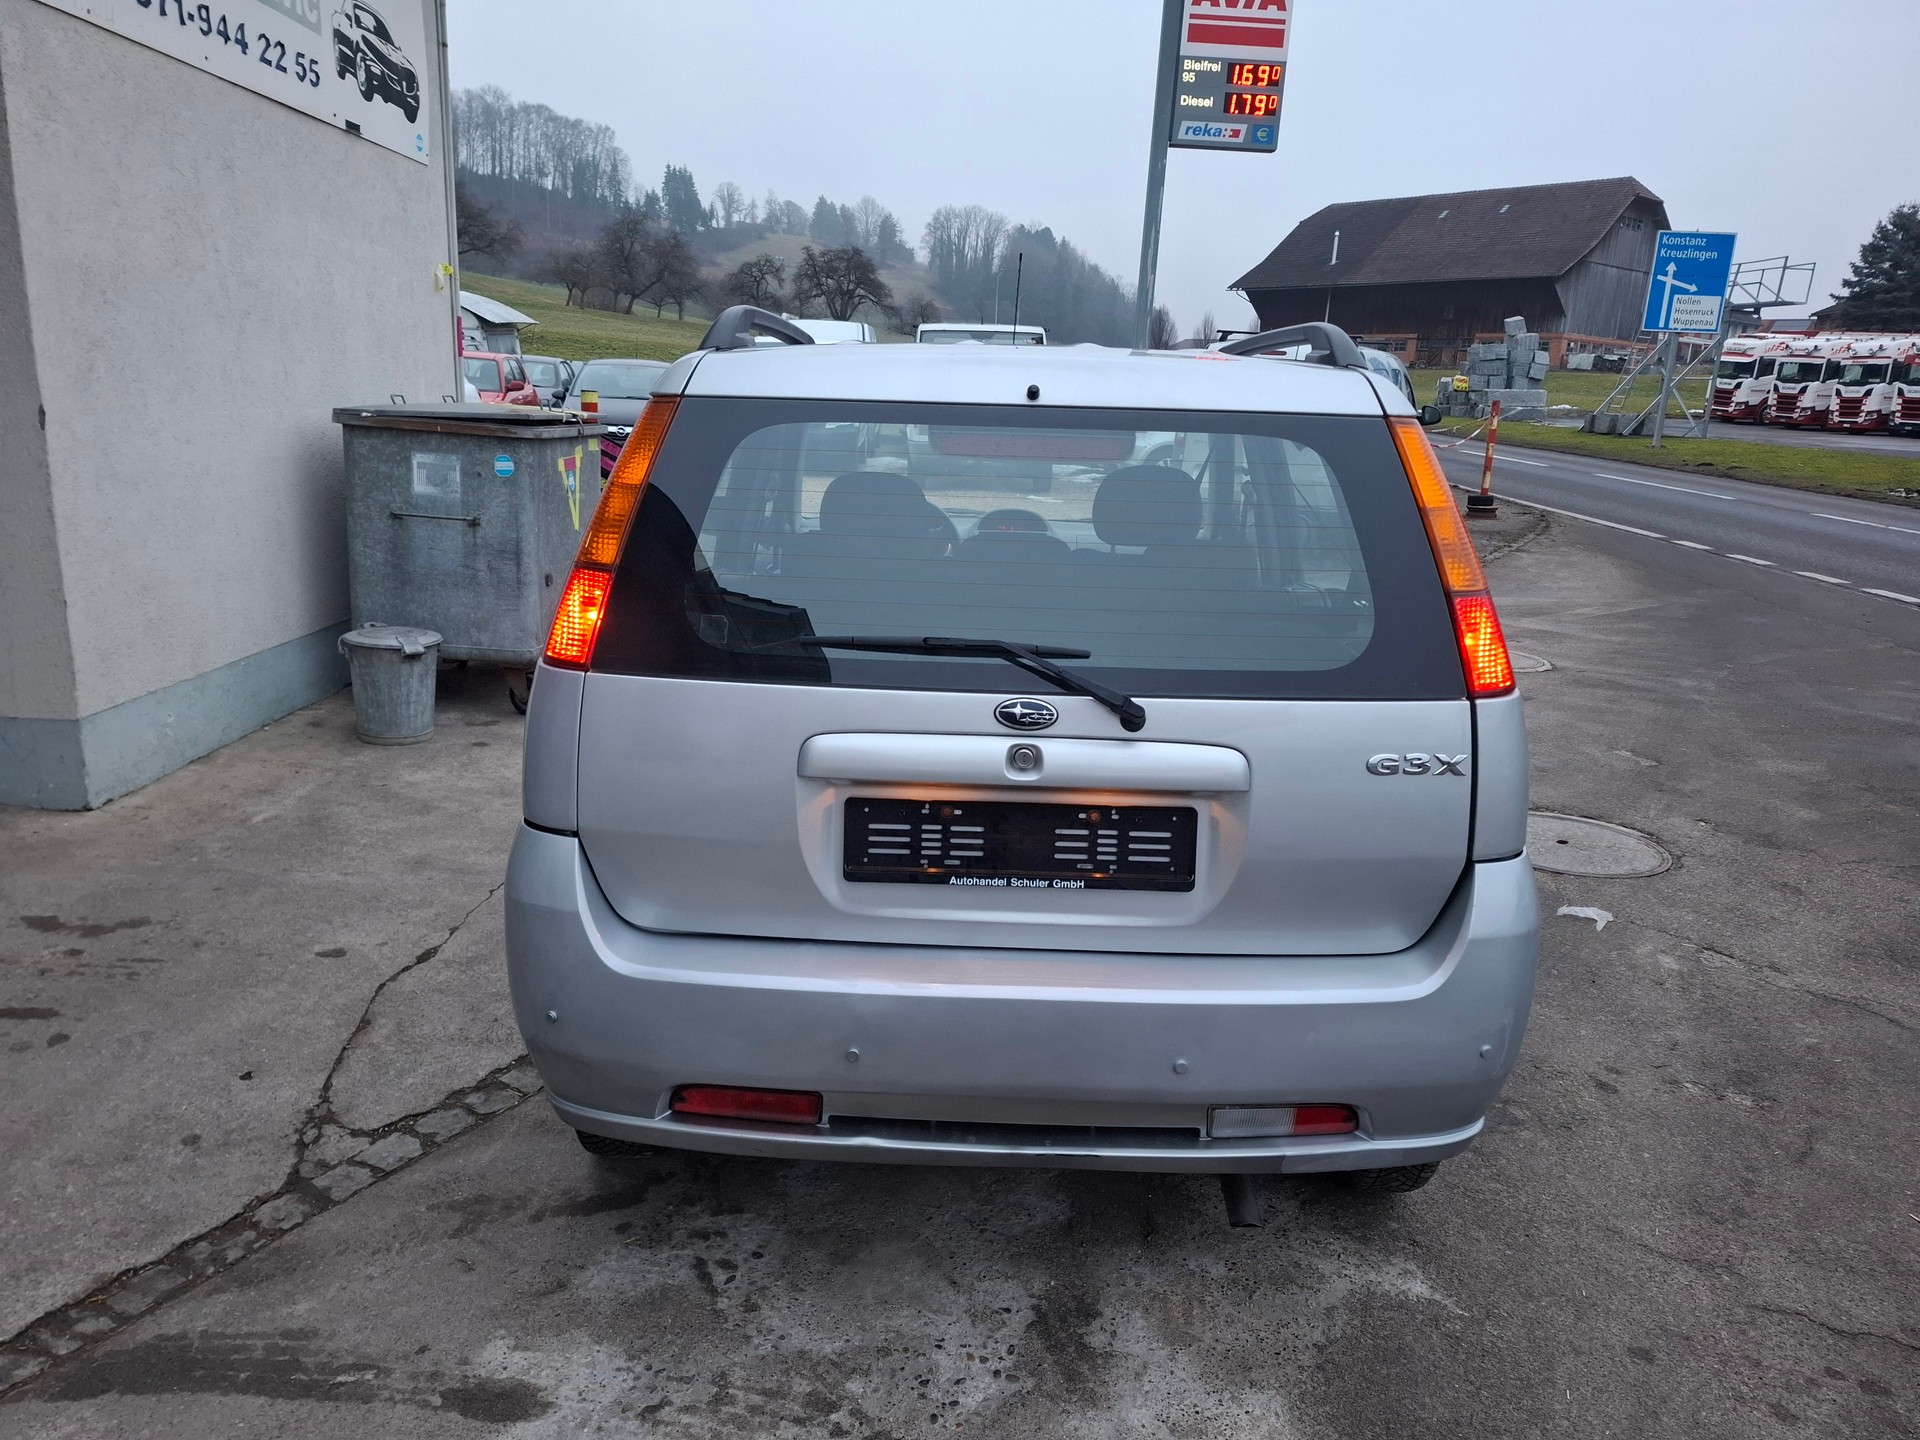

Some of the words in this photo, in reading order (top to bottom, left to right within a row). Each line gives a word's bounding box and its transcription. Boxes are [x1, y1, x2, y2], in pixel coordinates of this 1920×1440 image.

[257, 33, 288, 74] 22
[295, 51, 320, 88] 55
[1183, 59, 1222, 73] Bleifrei
[1182, 72, 1196, 83] 95
[1180, 95, 1214, 108] Diesel
[1662, 234, 1707, 246] Konstanz
[1660, 247, 1718, 262] Kreuzlingen
[1676, 297, 1702, 306] Nollen
[1674, 307, 1715, 316] Hosenruck
[1673, 317, 1714, 328] Wuppenau
[1365, 752, 1468, 776] G3X
[949, 875, 1007, 887] Autohandel
[1010, 877, 1050, 888] Schuler
[1053, 879, 1085, 889] GmbH
